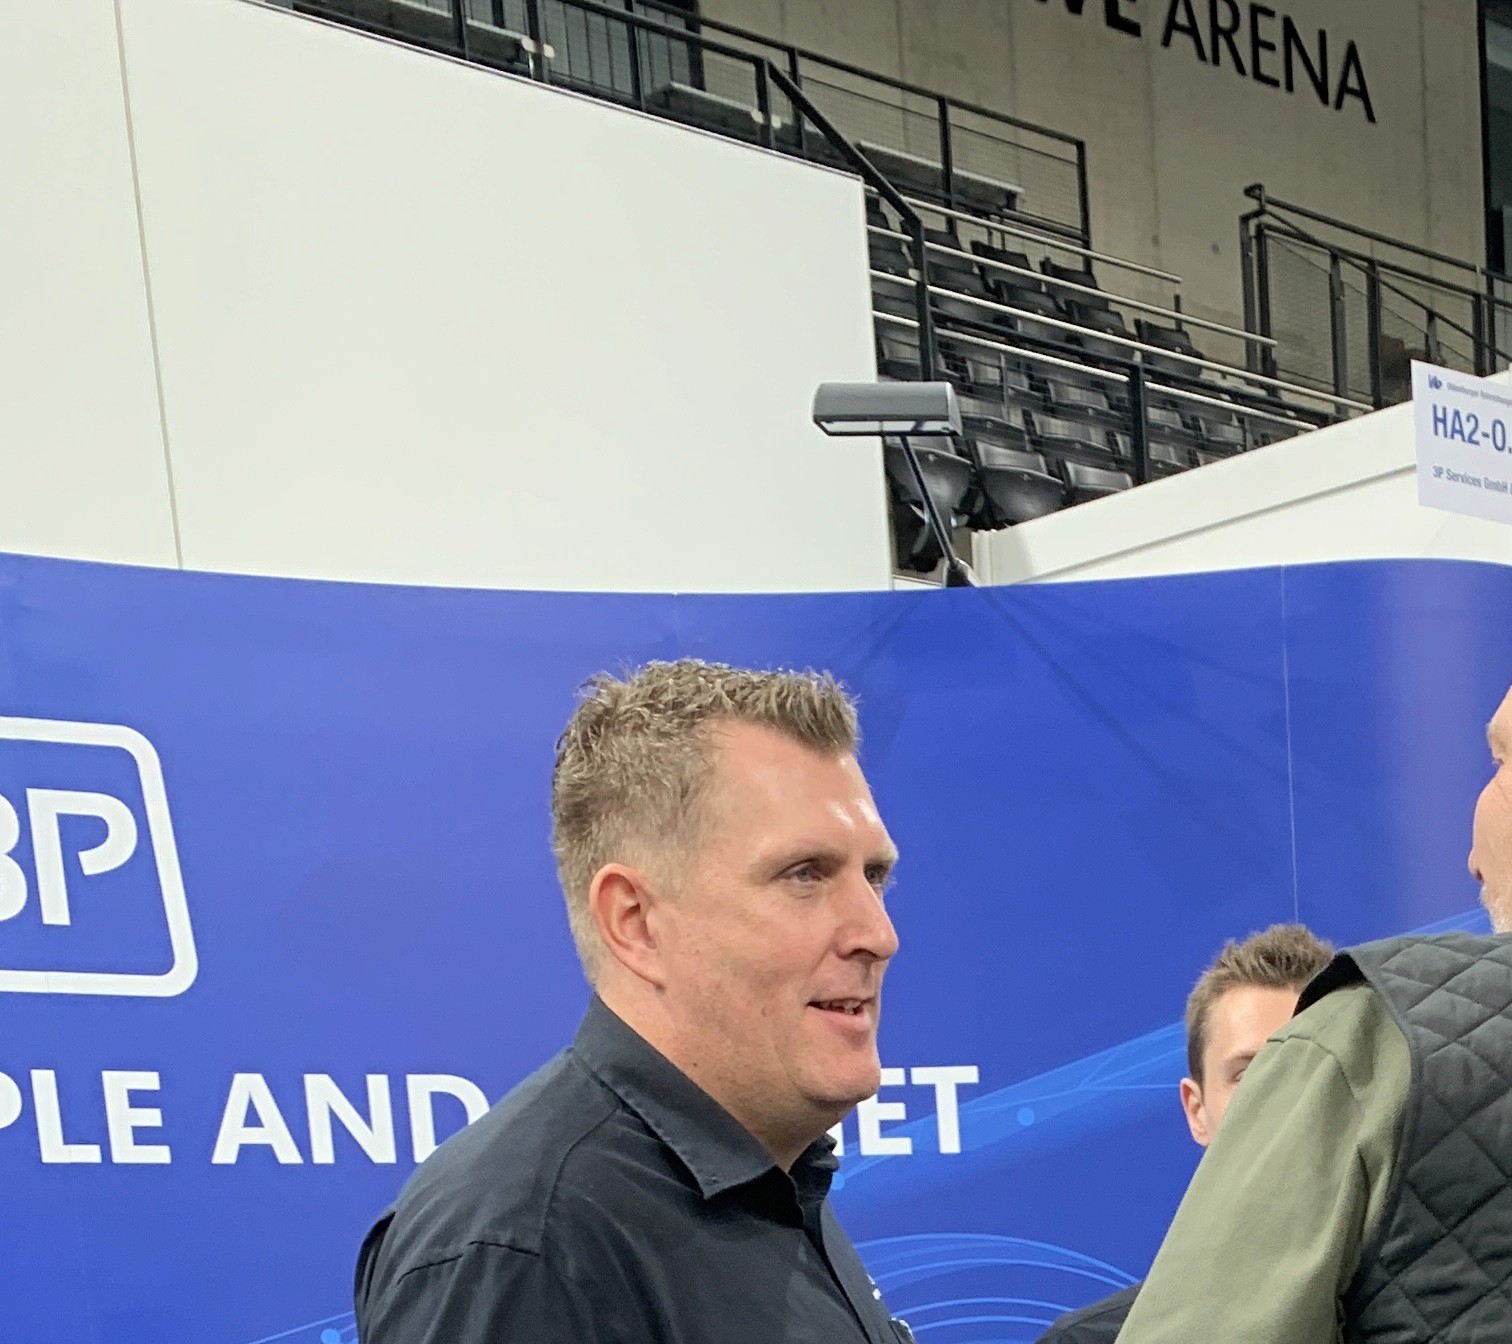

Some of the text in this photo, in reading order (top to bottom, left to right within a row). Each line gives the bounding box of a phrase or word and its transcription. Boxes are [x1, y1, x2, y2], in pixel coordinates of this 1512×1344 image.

[1161, 0, 1377, 124] ARENA
[1433, 465, 1444, 478] 3P
[1446, 468, 1482, 488] Services
[1484, 477, 1508, 494] GmbH
